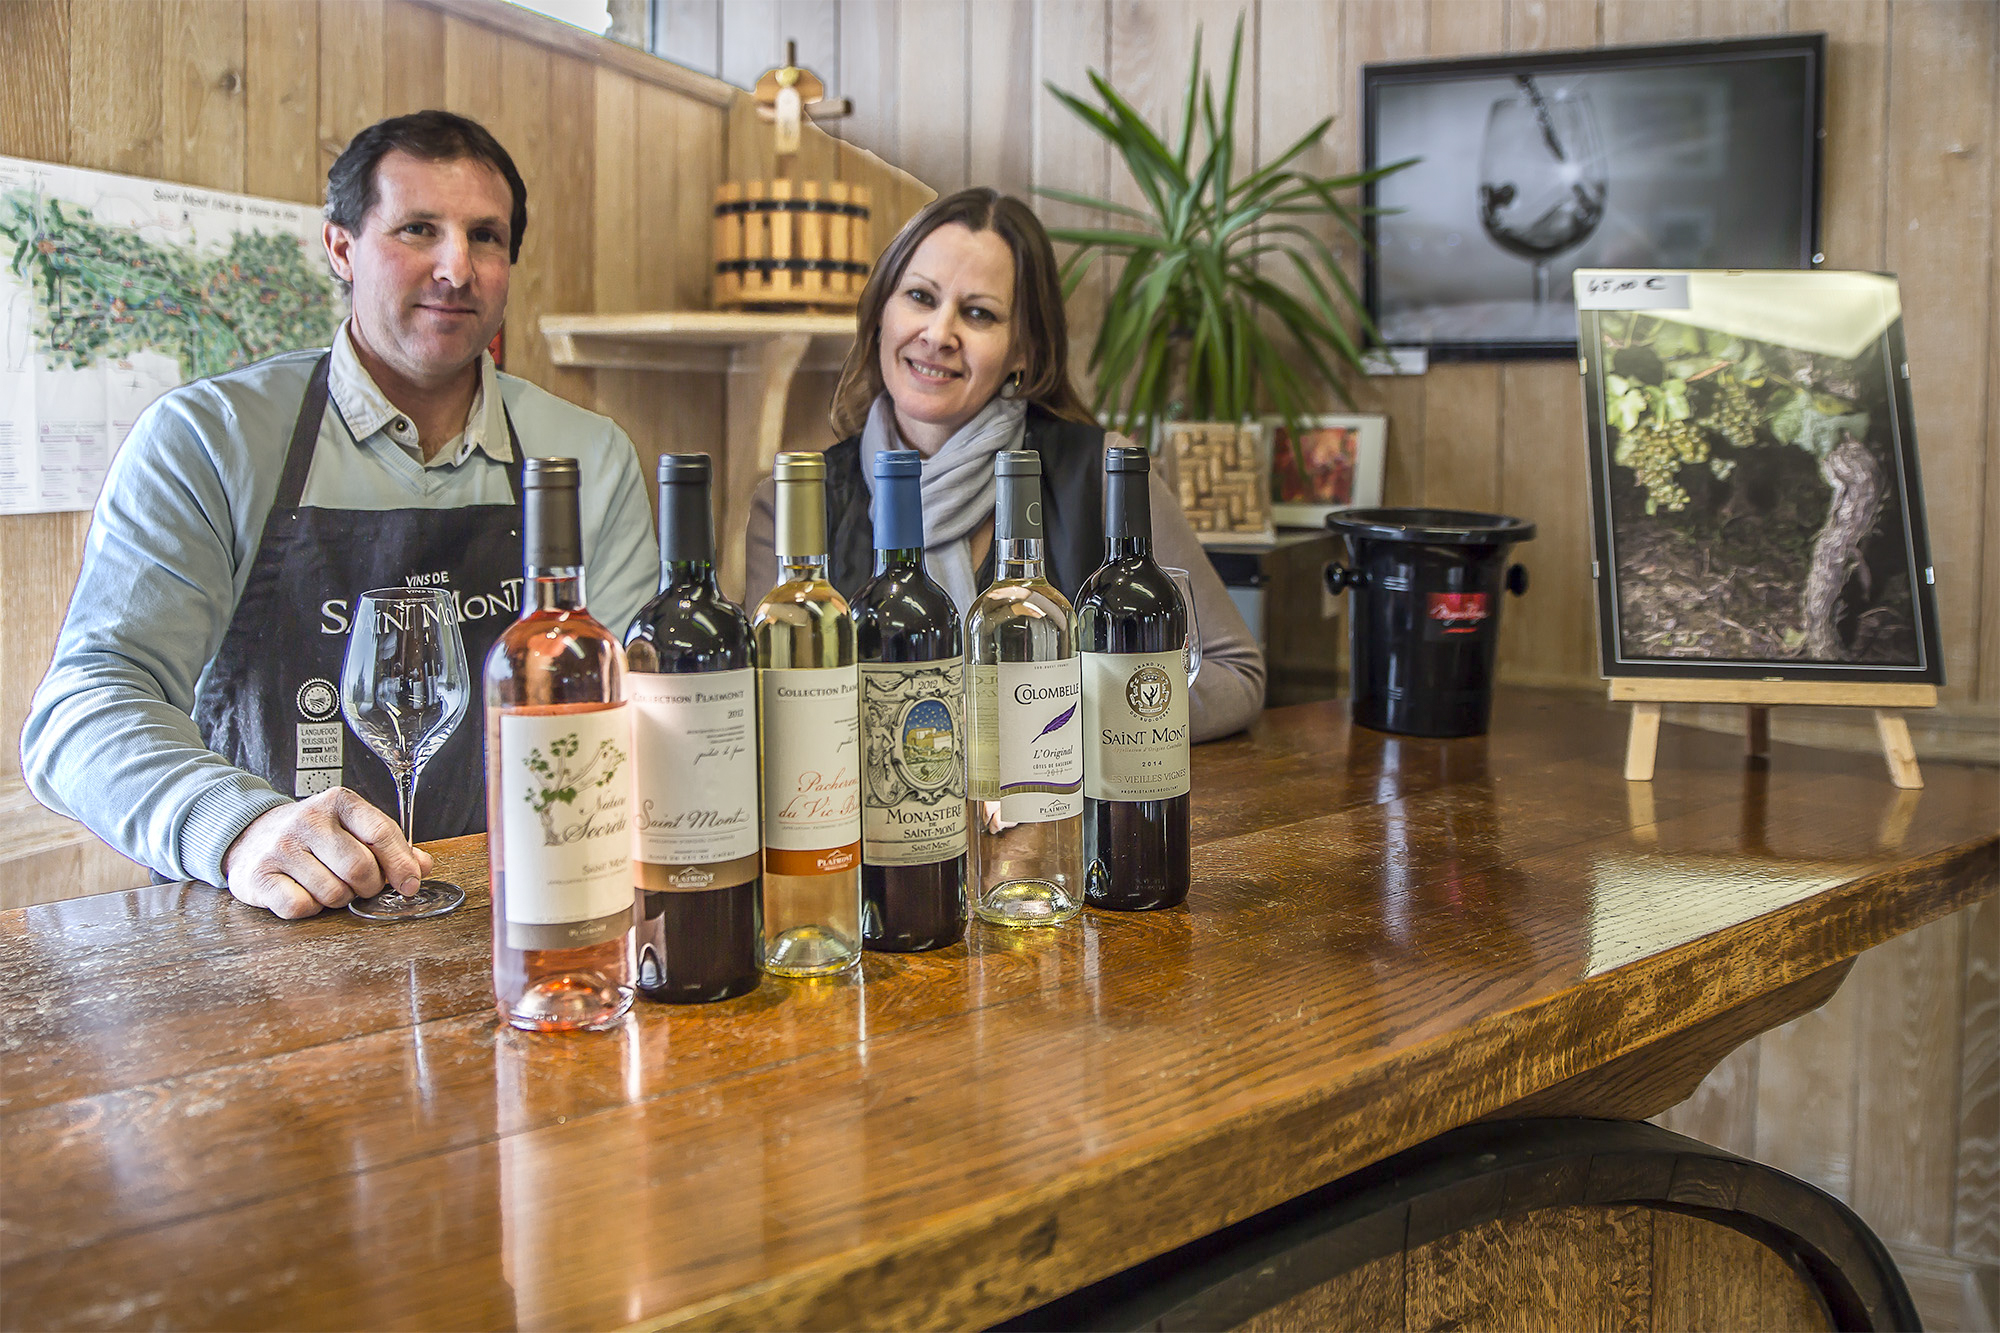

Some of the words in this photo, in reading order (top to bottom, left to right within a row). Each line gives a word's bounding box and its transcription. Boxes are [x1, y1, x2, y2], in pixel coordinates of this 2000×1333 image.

[405, 574, 430, 588] VINS
[431, 571, 449, 585] DE
[1133, 662, 1154, 671] GRAND
[777, 686, 839, 697] COLLECTION
[918, 679, 938, 690] 2012
[695, 690, 744, 703] PLAIMONT
[1014, 682, 1079, 705] COLOMBELLE
[301, 728, 338, 736] LANGUEDOC
[1102, 729, 1147, 745] SAINT
[1152, 724, 1187, 744] MONT
[301, 737, 338, 745] ROUSSILLON
[1033, 745, 1073, 760] L'Original
[1124, 774, 1162, 784] VIEILLES
[1164, 768, 1186, 781] VIGNES
[778, 794, 807, 818] du
[804, 796, 833, 818] Vic
[1039, 804, 1070, 814] PLAIMONT
[634, 799, 684, 831] Saint
[686, 807, 750, 829] Mont
[904, 822, 957, 839] SAINT-MONT
[911, 843, 931, 853] SAINT
[816, 853, 853, 868] PLAIMONT
[669, 872, 715, 884] PLAIMONT
